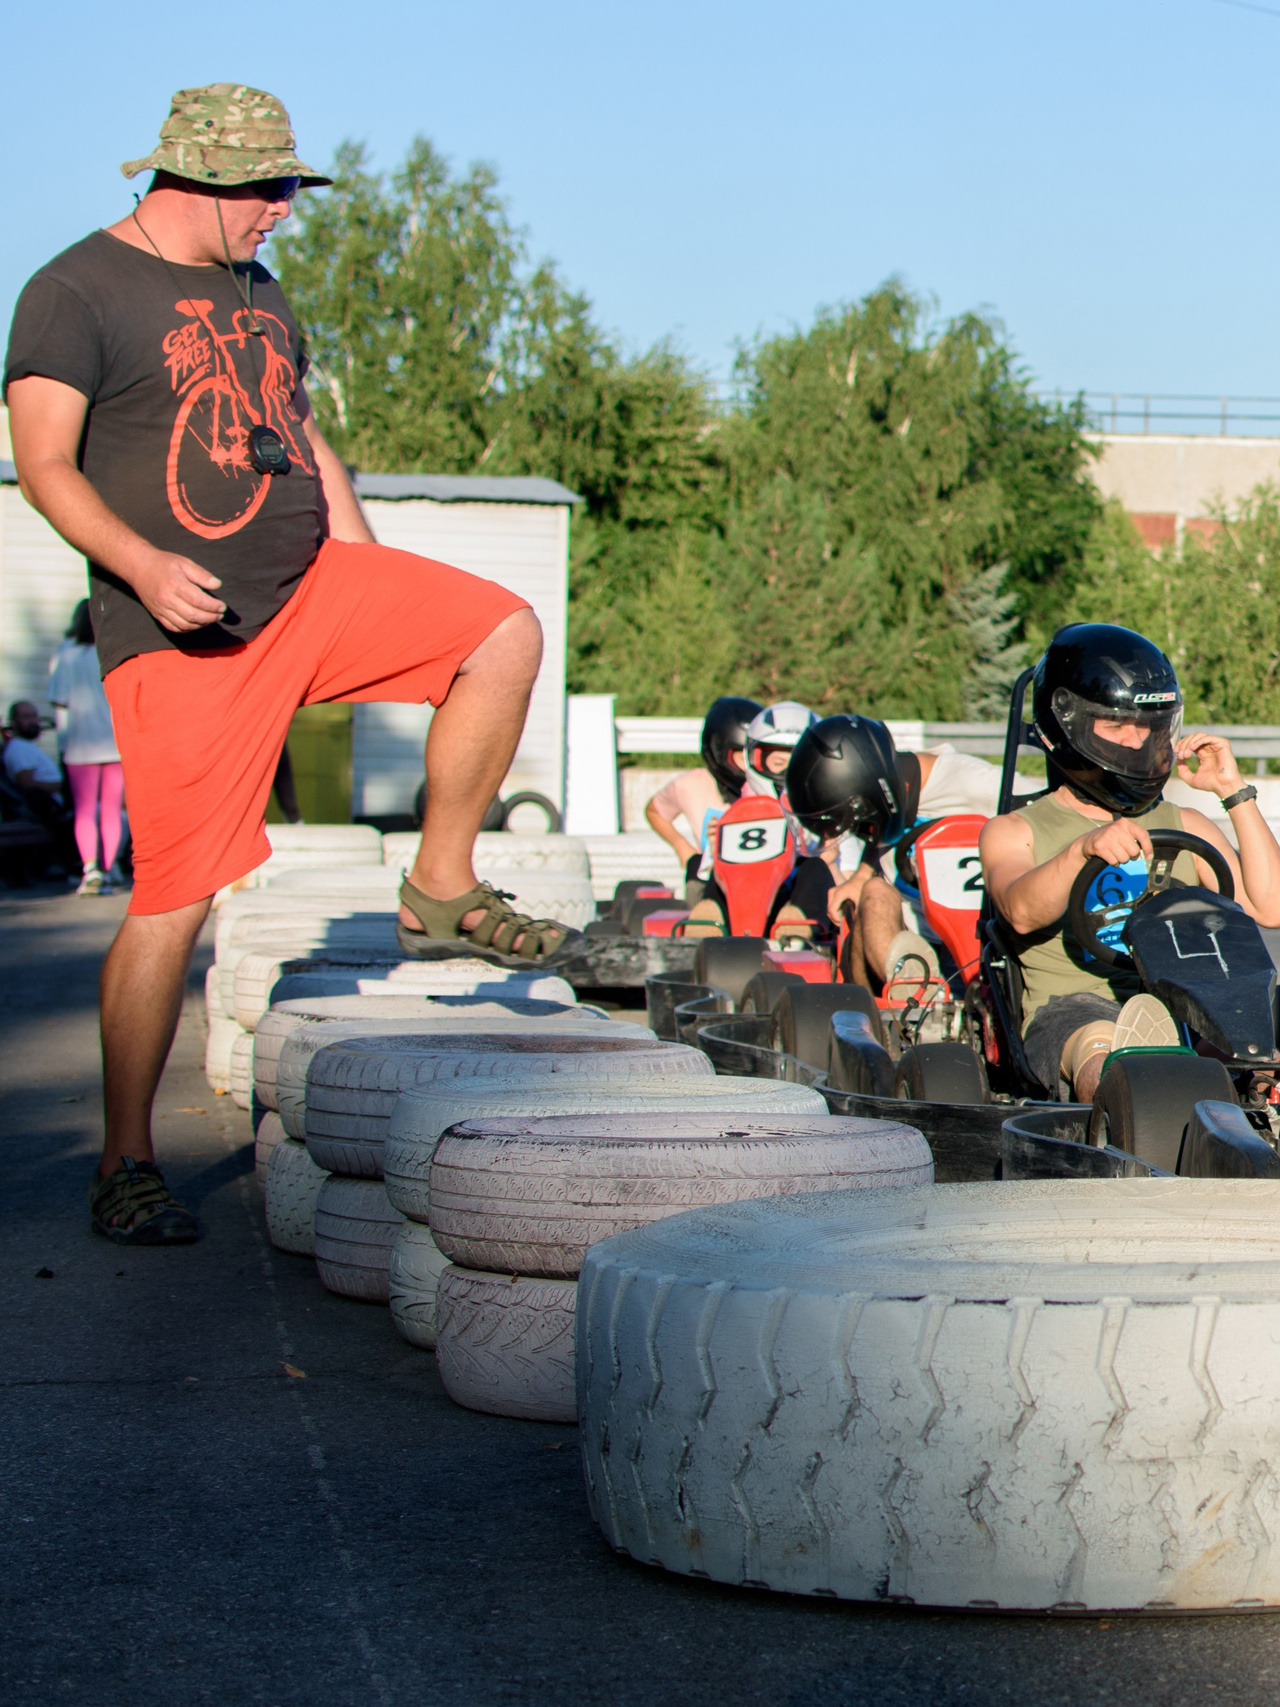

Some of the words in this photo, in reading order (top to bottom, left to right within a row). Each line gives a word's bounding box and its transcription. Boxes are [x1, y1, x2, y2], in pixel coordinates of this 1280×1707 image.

[162, 321, 201, 354] GET
[164, 336, 211, 391] FREE
[739, 828, 767, 850] 8
[958, 856, 985, 891] 2
[1164, 920, 1229, 977] 4
